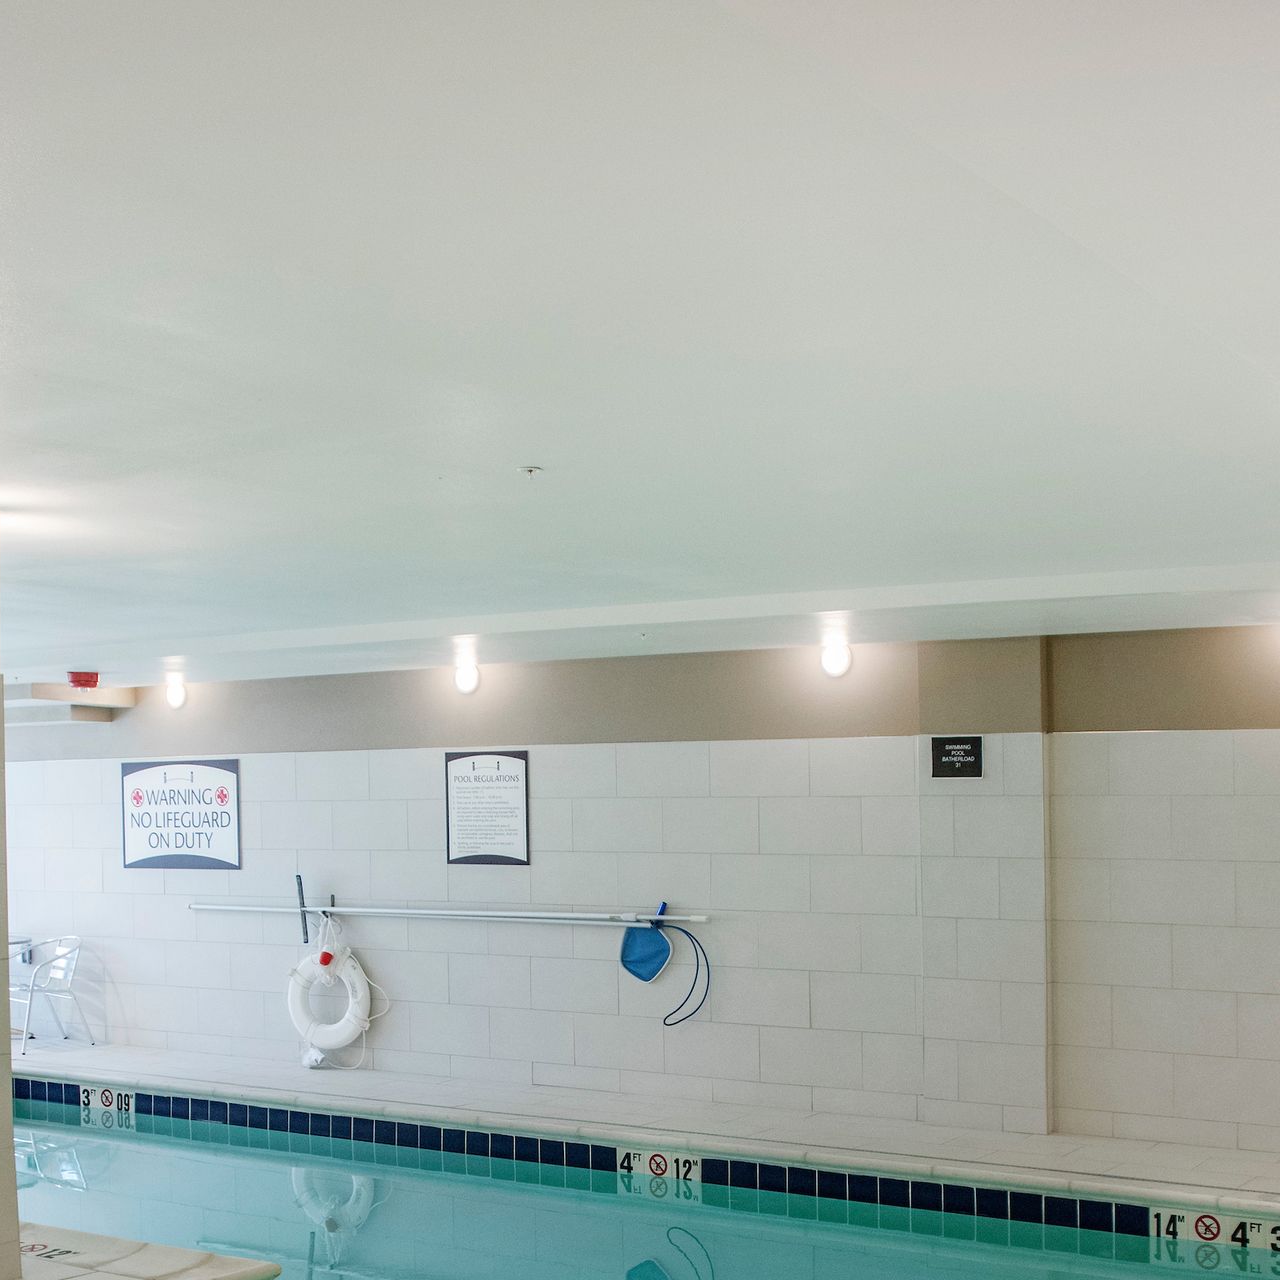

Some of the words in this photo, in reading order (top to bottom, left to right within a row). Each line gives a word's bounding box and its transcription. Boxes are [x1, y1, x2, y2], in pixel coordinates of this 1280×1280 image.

[453, 775, 472, 783] POOL
[473, 774, 520, 783] REGULATIONS
[145, 788, 213, 806] WARNING
[130, 812, 152, 828] NO
[155, 811, 231, 828] LIFEGUARD
[148, 832, 170, 848] ON
[175, 832, 214, 848] DUTY
